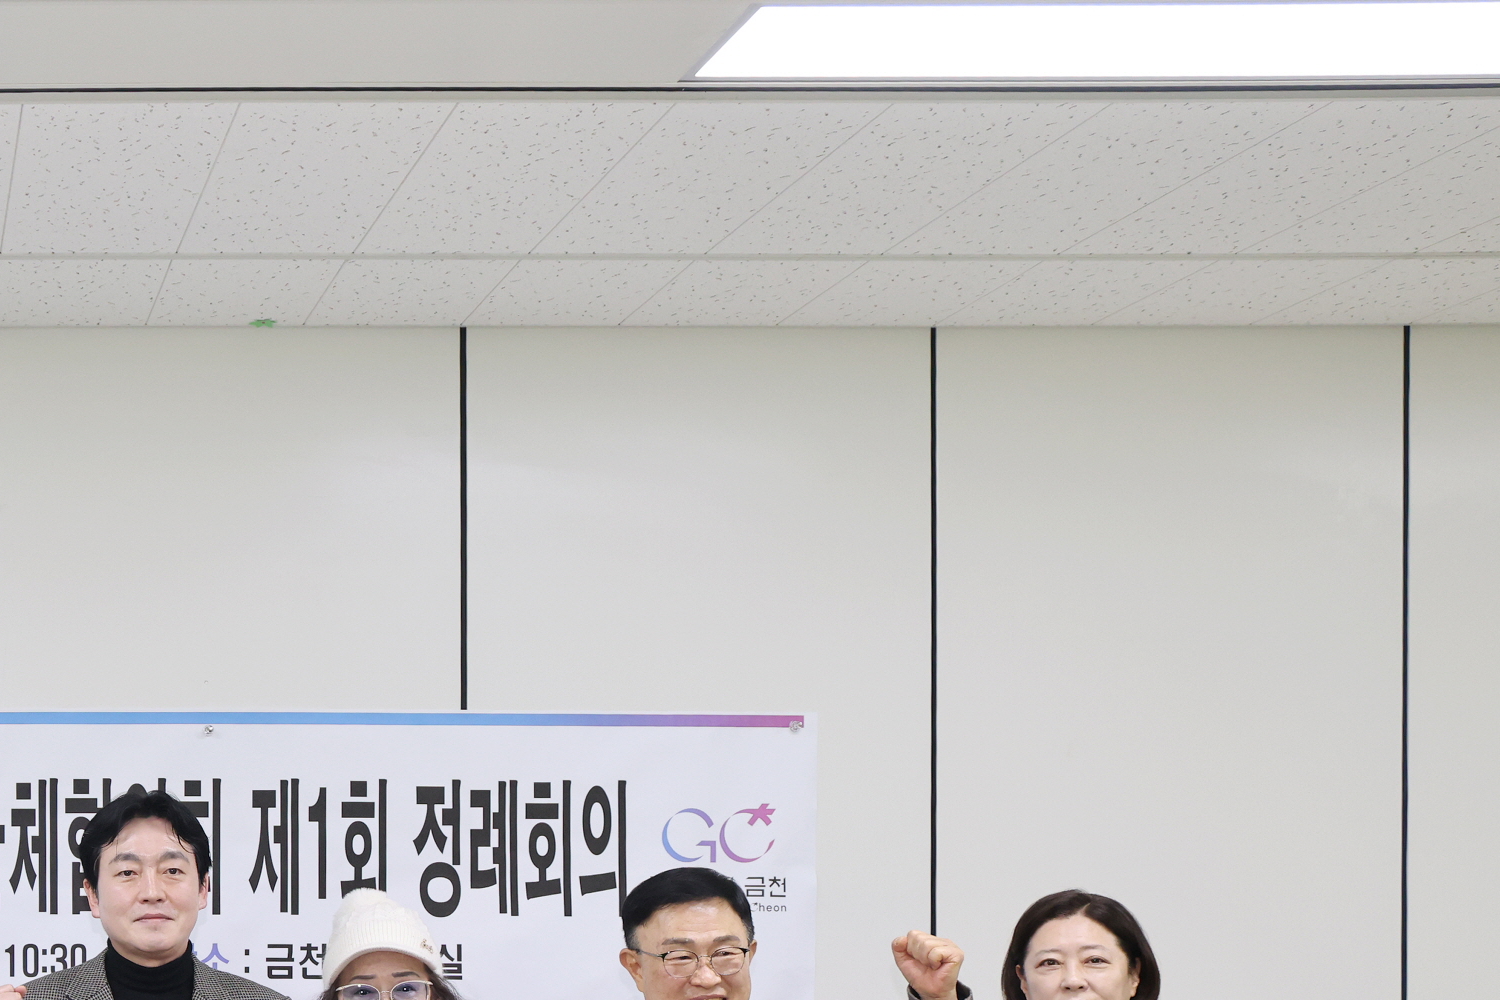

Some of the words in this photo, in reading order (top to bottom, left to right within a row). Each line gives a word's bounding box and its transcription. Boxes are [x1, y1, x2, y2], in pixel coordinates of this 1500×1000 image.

[248, 778, 387, 915] 제1회
[412, 779, 626, 918] 정례회의
[744, 876, 786, 898] 금천
